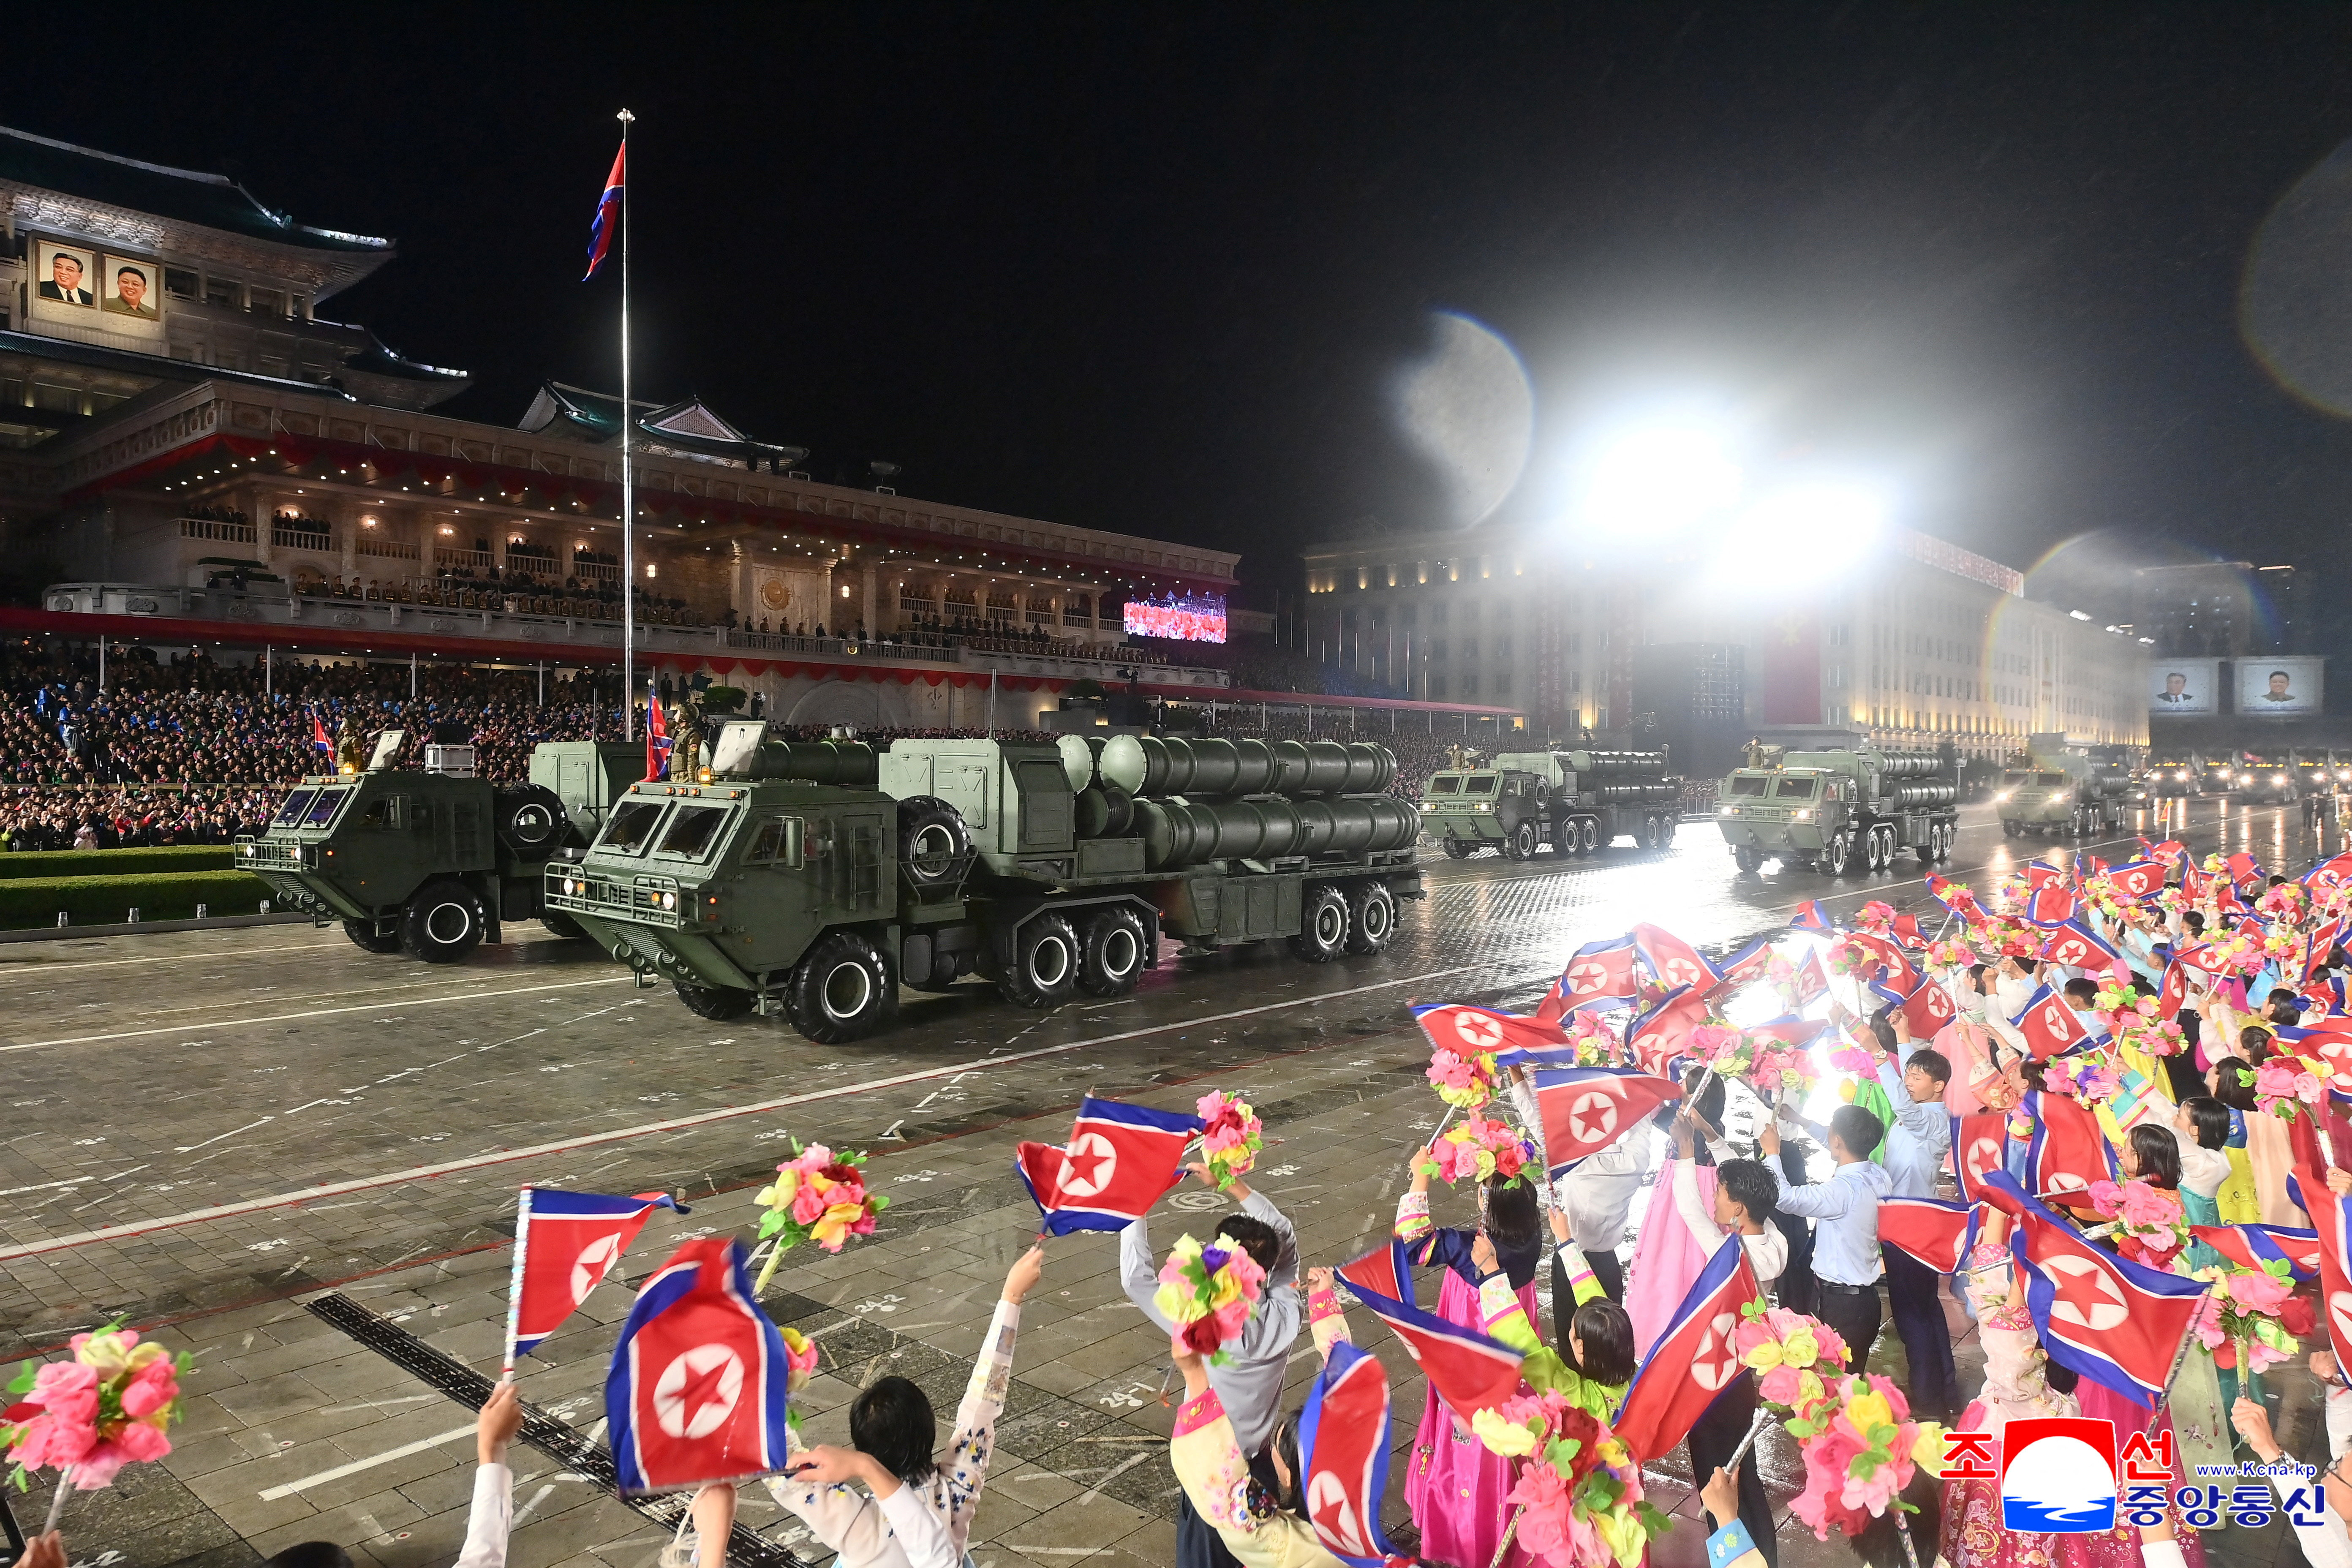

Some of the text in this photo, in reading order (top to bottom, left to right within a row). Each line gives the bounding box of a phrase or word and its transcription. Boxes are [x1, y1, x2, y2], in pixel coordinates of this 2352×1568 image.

[670, 1226, 717, 1240] 24-3
[382, 1306, 417, 1318] 25-3
[855, 1294, 906, 1313] 24-2
[1100, 1382, 1157, 1408] 24-1
[547, 1397, 593, 1416] 25-2
